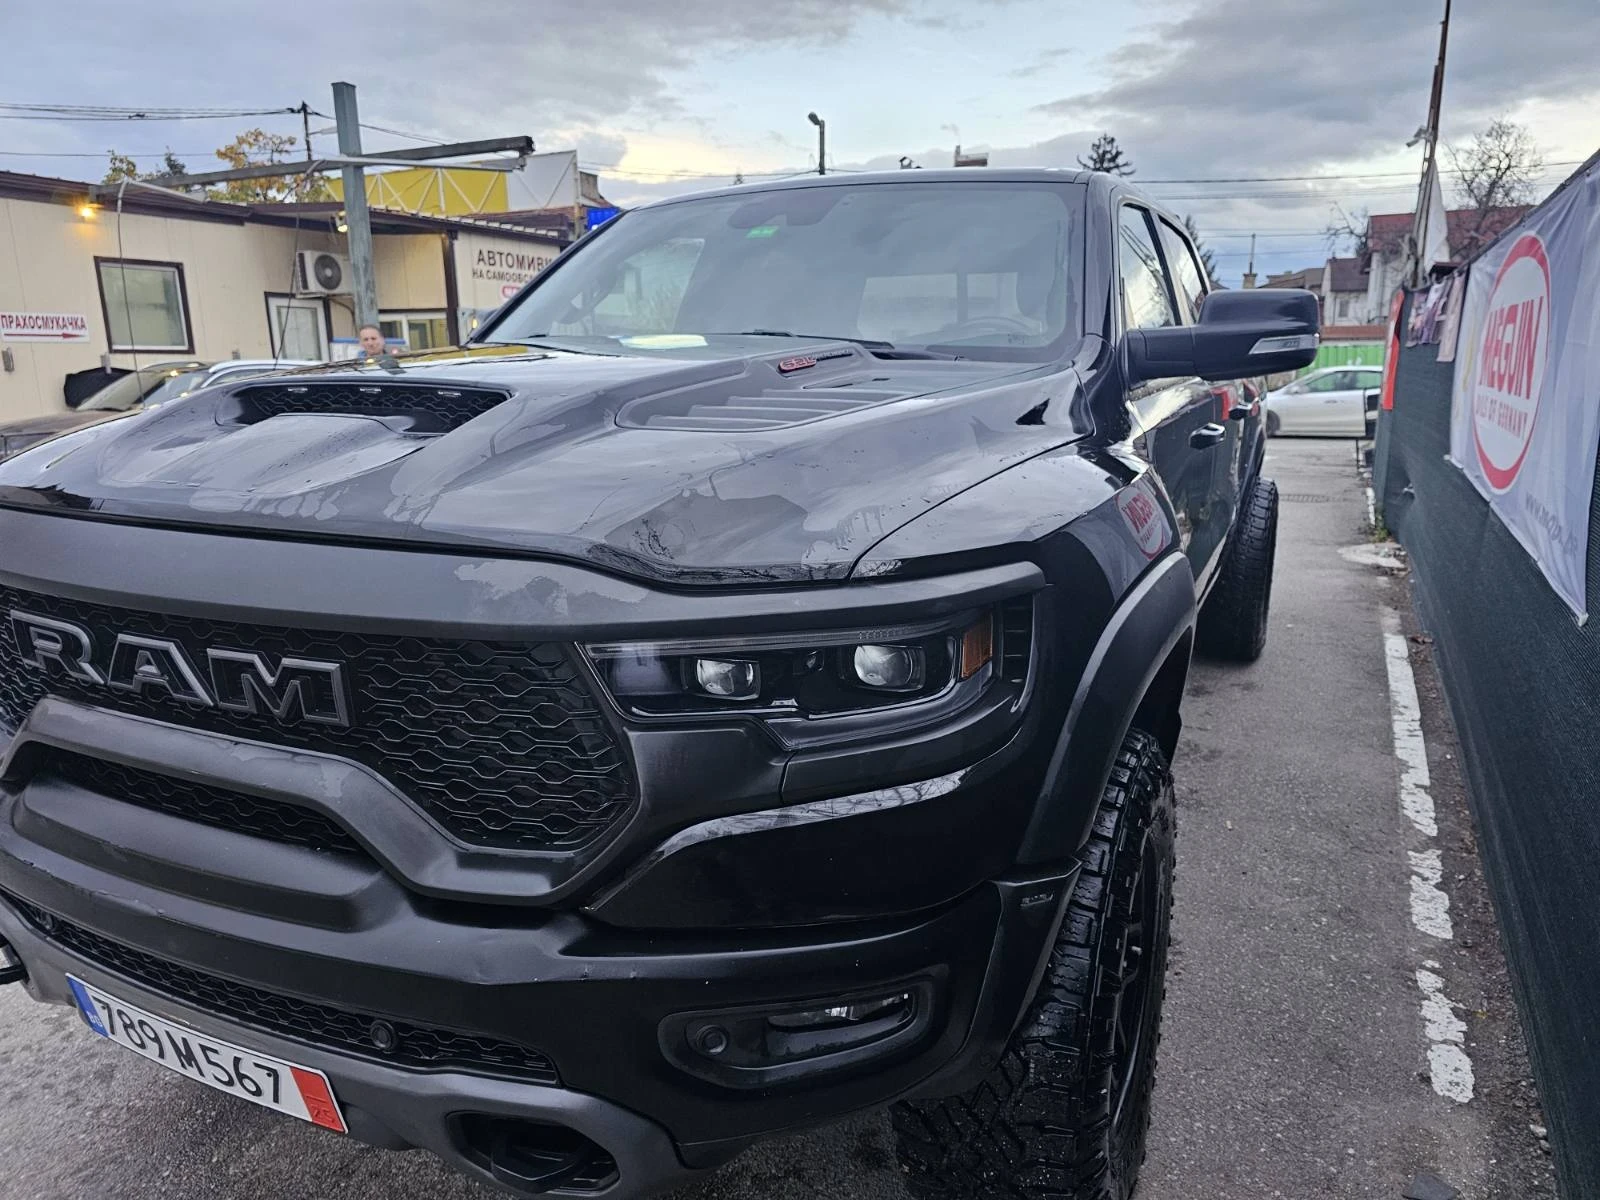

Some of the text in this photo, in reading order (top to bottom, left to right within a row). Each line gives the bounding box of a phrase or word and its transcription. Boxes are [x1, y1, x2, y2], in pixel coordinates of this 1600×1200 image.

[486, 270, 534, 284] САМООБС
[1, 314, 87, 330] ПРАХОСМУКАЧКА
[1479, 296, 1544, 400] MEGUIN
[10, 609, 349, 727] RAM
